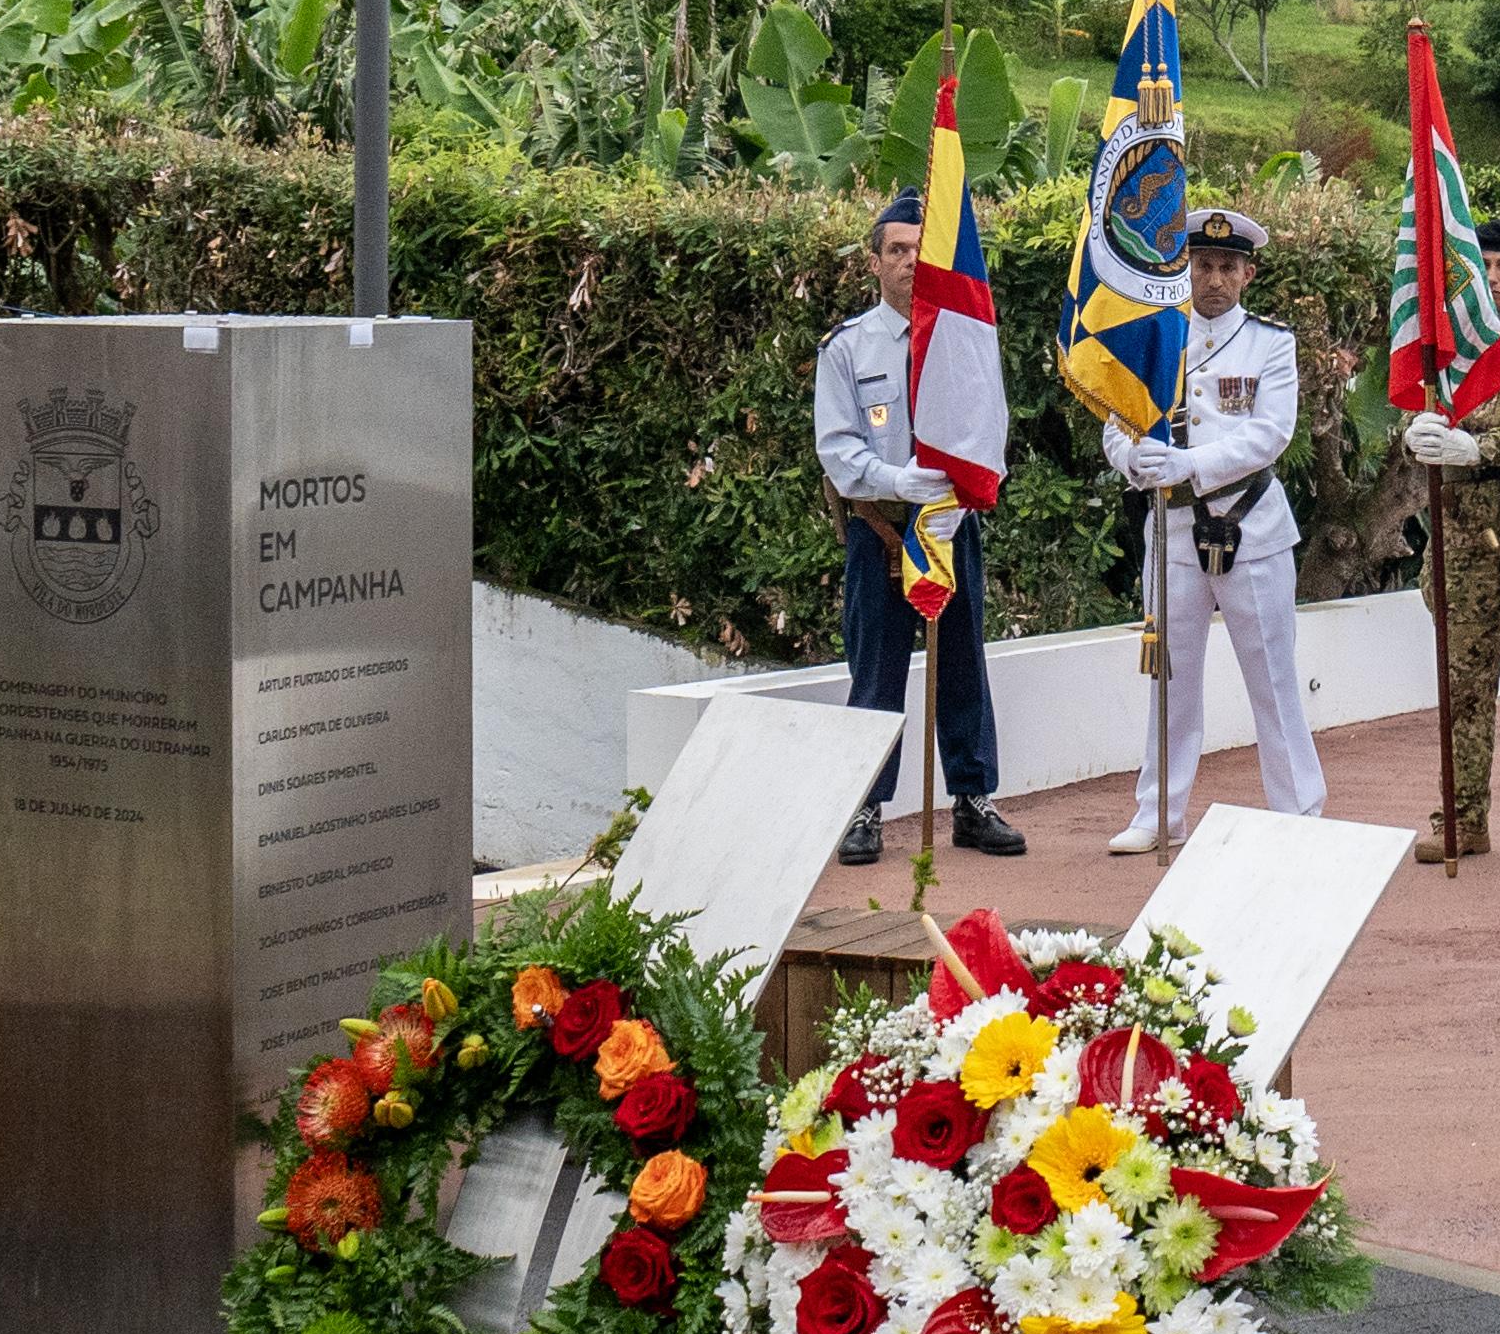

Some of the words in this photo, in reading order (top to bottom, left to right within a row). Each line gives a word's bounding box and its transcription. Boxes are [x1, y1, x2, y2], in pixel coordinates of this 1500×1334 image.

[1090, 137, 1121, 241] COMANDO
[259, 473, 366, 511] MORTOS
[259, 529, 297, 563] EM
[259, 568, 405, 614] CAMPANHA
[258, 676, 292, 693] ARTUR
[293, 667, 340, 688] FURTADO
[341, 665, 356, 680] DE
[357, 658, 410, 677] MEDEIROS
[77, 685, 98, 700] DO
[99, 688, 168, 706] MUNICÍPIO
[91, 710, 119, 727] QUE
[121, 713, 198, 733] MORRERAM
[258, 725, 298, 745] CARLOS
[299, 721, 327, 737] MOTA
[328, 717, 343, 733] DE
[343, 710, 390, 729] OLIVEIRA
[43, 730, 65, 744] NA
[65, 732, 118, 750] GUERRA
[120, 737, 140, 752] DO
[141, 739, 212, 758] ULTRAMAR
[258, 778, 286, 797] DINIS
[286, 770, 326, 790] SOARES
[327, 762, 379, 783] PIMENTEL
[13, 797, 26, 812] 18
[28, 799, 46, 814] DE
[48, 801, 92, 818] JULHO
[94, 807, 112, 820] DE
[114, 808, 145, 823] 2024
[258, 829, 307, 848] EMANUEL
[307, 813, 368, 837] AGOSTINHO
[368, 803, 409, 823] SOARES
[409, 797, 441, 815] LOPES
[258, 877, 305, 899] ERNESTO
[306, 869, 347, 888] CABRAL
[347, 856, 395, 877] PACHECO
[288, 917, 345, 943] DOMINGOS
[286, 973, 320, 995] BENTO
[321, 961, 368, 984] PACHECO
